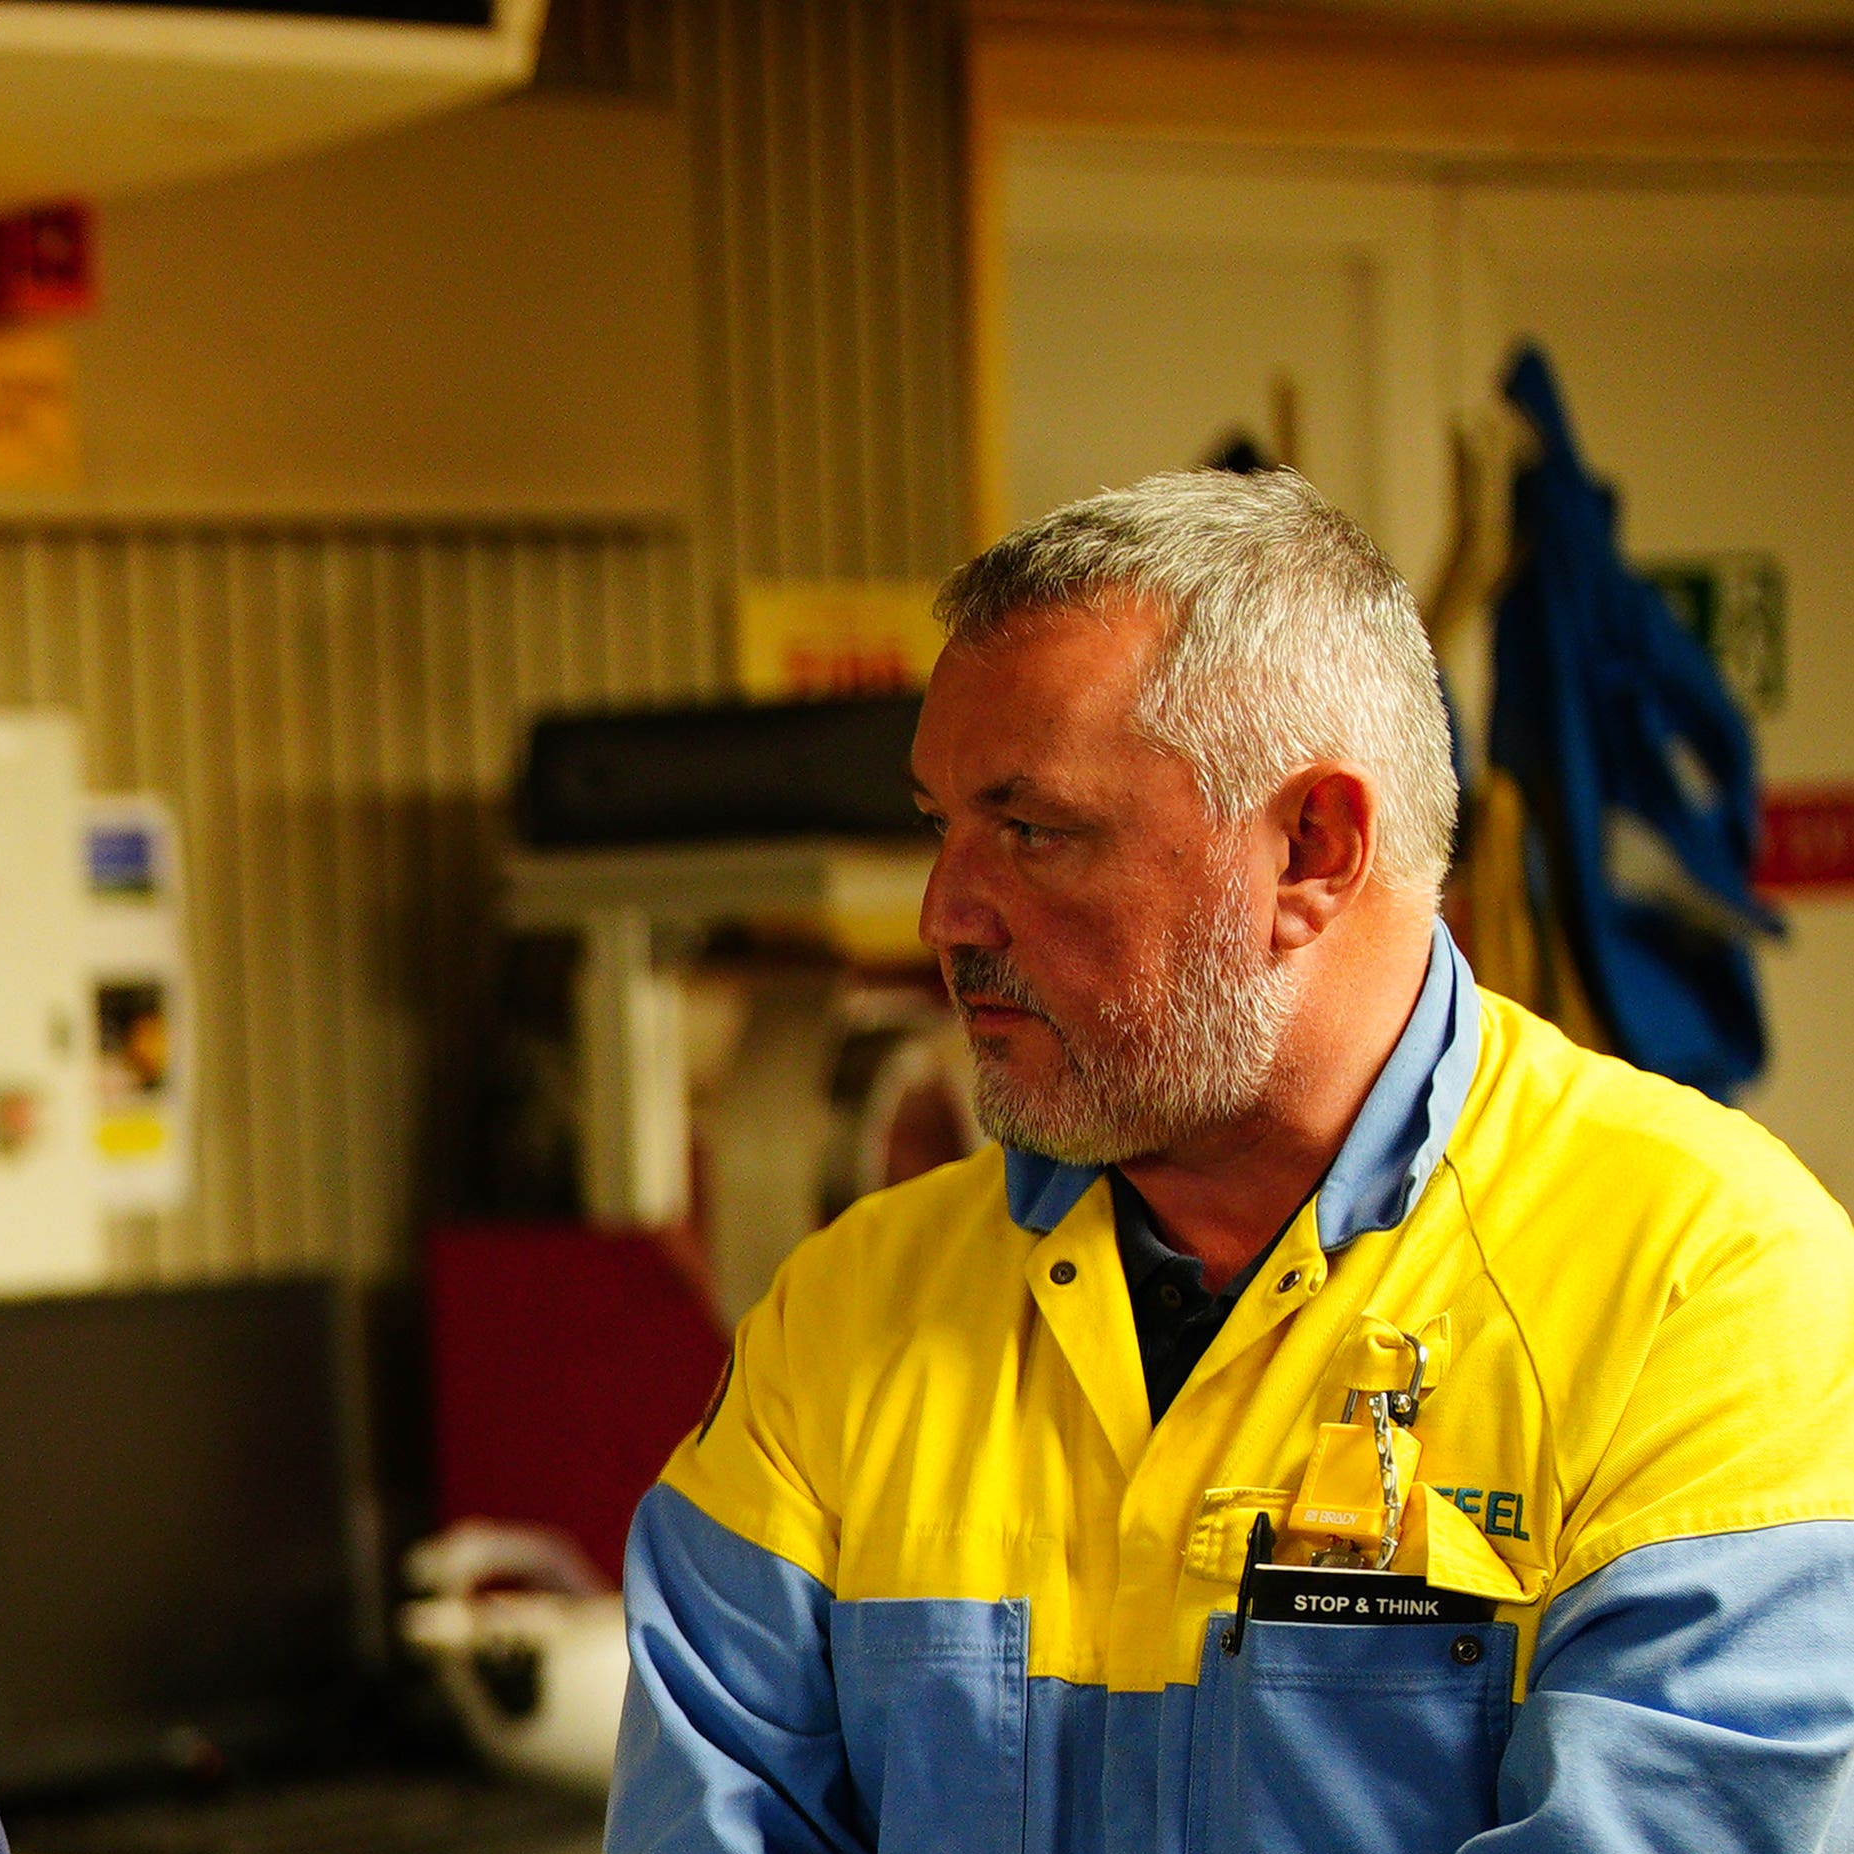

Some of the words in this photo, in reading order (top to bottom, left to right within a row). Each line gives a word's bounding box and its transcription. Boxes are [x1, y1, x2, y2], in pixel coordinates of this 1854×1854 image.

[1294, 1594, 1350, 1613] STOP
[1355, 1597, 1371, 1614] &
[1376, 1598, 1440, 1617] THINK
